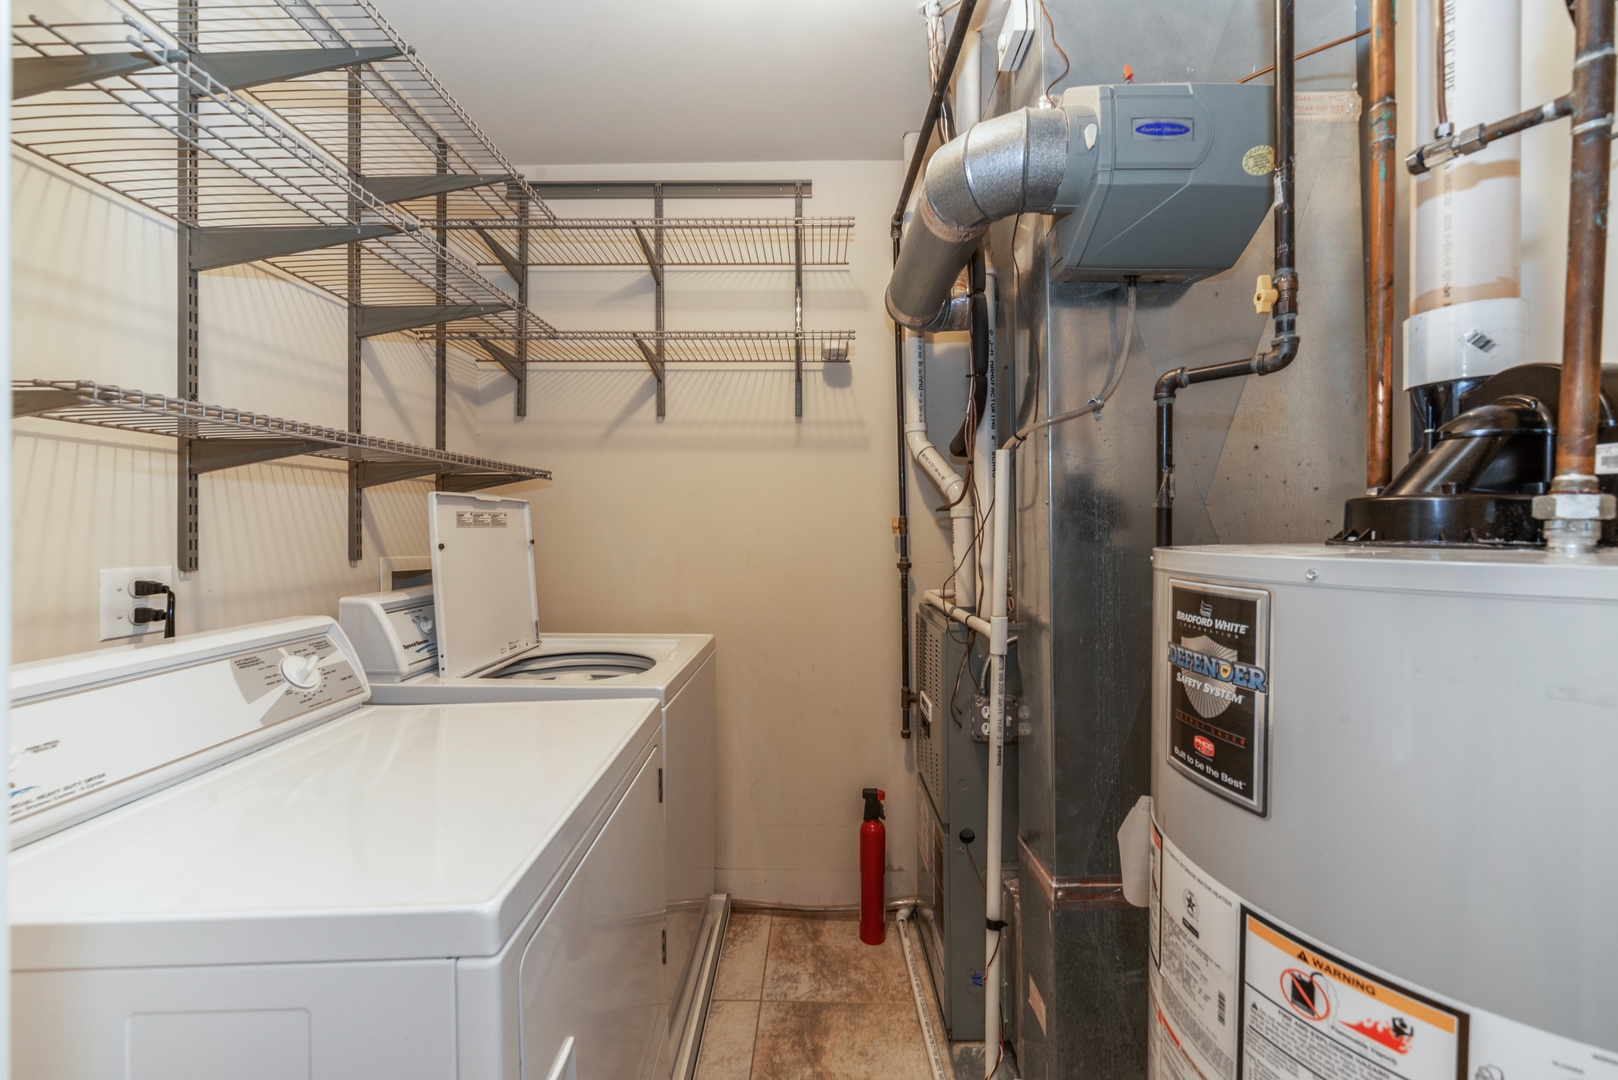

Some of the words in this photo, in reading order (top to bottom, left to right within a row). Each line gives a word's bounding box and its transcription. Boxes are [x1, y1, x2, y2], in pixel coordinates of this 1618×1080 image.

[1176, 610, 1213, 628] BRADFORD
[1214, 618, 1248, 635] WHITE
[1168, 641, 1267, 695] DEFENDER
[1176, 672, 1202, 690] SAFETY
[1203, 682, 1244, 705] SYSTEM
[1175, 708, 1205, 730] ENERGY
[1211, 726, 1246, 747] SAVER
[36, 788, 61, 801] HEAVY
[63, 780, 82, 792] DUTY
[84, 772, 106, 784] DRYER
[1174, 746, 1187, 760] Built
[1187, 754, 1194, 765] to
[1195, 759, 1205, 770] be
[1206, 764, 1220, 778] the
[1220, 772, 1244, 790] Best
[1180, 862, 1196, 881] STORAGE
[1197, 878, 1212, 892] WATER
[1212, 889, 1232, 908] HEATER
[1312, 956, 1376, 997] WARNING
[1294, 1021, 1309, 1033] AND
[1310, 1030, 1354, 1060] EXPLOSION
[1354, 1056, 1390, 1080] HAZARD
